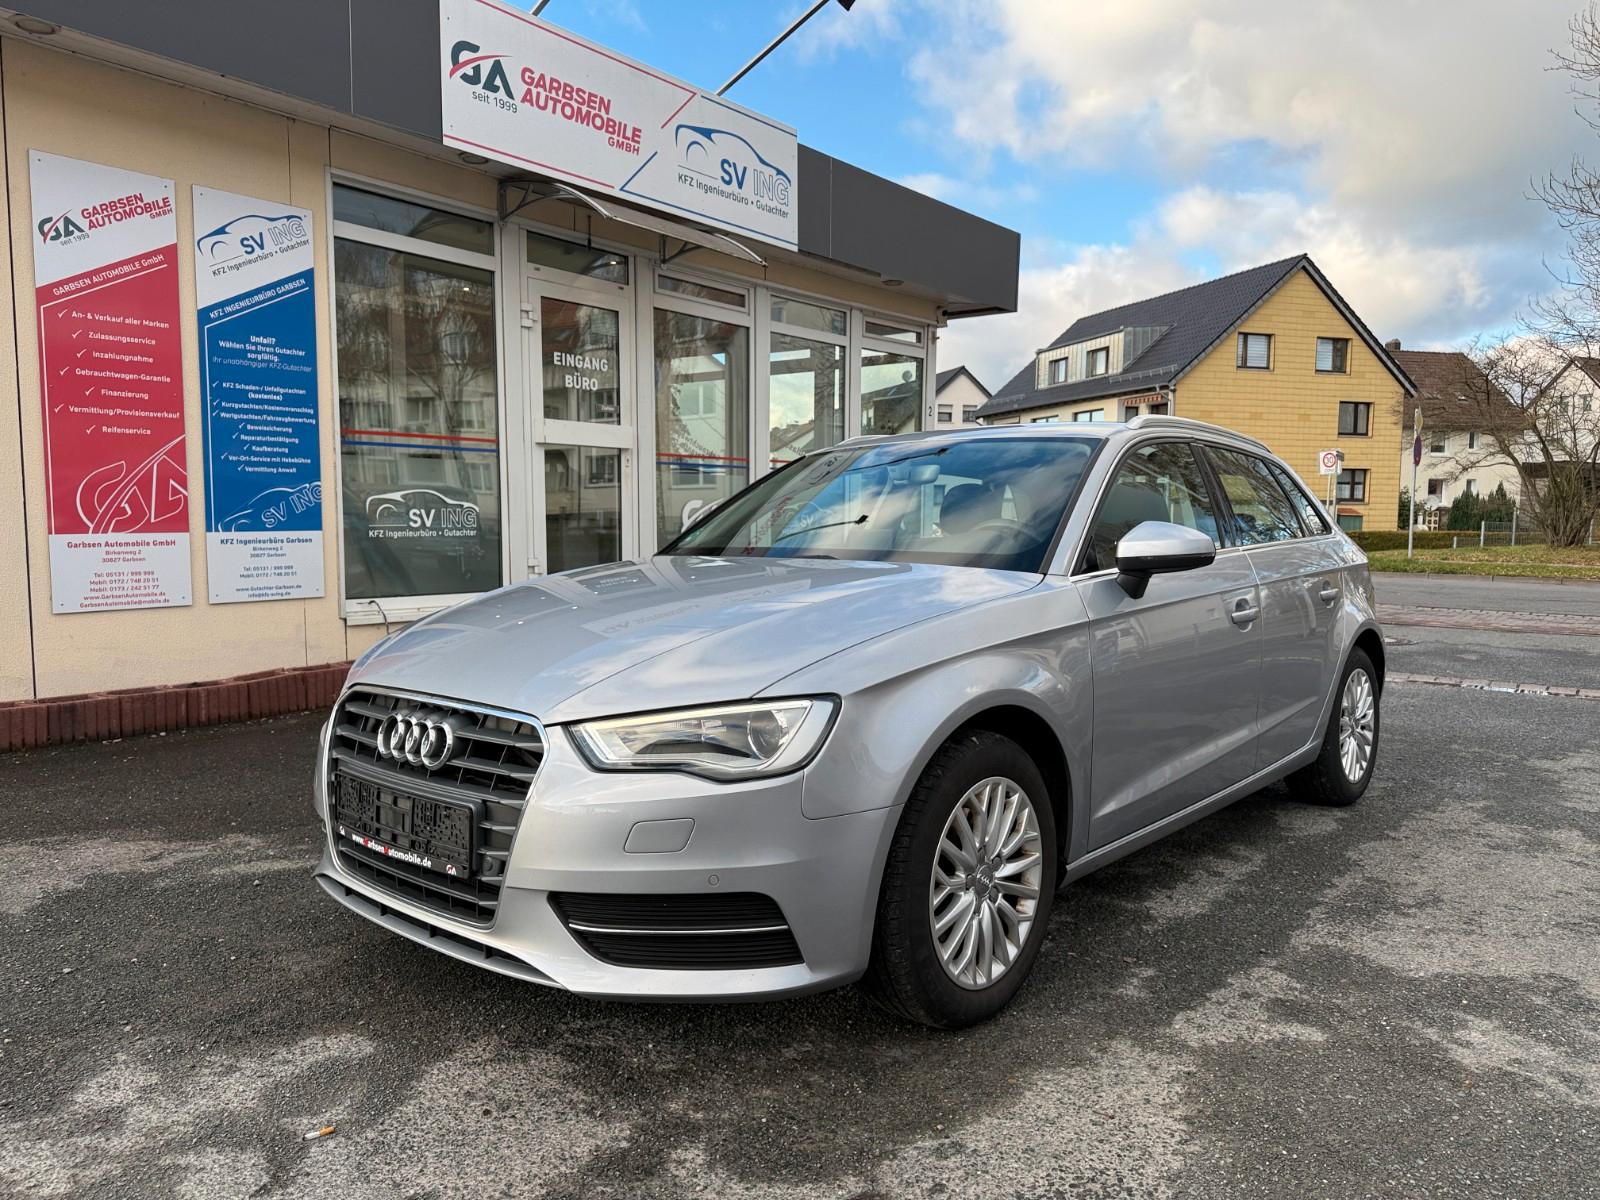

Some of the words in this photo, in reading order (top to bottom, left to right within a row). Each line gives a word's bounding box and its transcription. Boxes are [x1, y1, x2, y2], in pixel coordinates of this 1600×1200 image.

[520, 67, 611, 115] GARBSEN
[472, 91, 490, 105] seit
[494, 97, 518, 113] 1999
[520, 88, 642, 145] AUTOMOBILE
[608, 137, 640, 156] GMBH
[720, 158, 747, 190] SV
[753, 168, 789, 207] ING
[678, 173, 694, 188] KFZ
[696, 179, 749, 206] Ingenieurbüro
[756, 201, 789, 219] Gutachter
[81, 193, 144, 220] GARBSEN
[88, 196, 171, 231] AUTOMOBILE
[150, 207, 173, 220] GMBH
[60, 236, 72, 247] seit
[73, 232, 90, 244] 1999
[240, 231, 266, 255] SV
[267, 218, 307, 247] ING
[212, 266, 227, 278] KFZ
[227, 250, 274, 273] Ingenieurbüro
[279, 238, 310, 255] Gutachter
[53, 277, 92, 296] GARBSEN
[92, 261, 141, 285] AUTOMOBILE
[142, 254, 165, 267] GmbH
[209, 308, 224, 319] KFZ
[224, 289, 277, 315] INGENIEURBÜRO
[276, 278, 306, 295] GARBSEN
[94, 313, 123, 323] Verkauf
[124, 317, 141, 326] aller
[143, 320, 170, 329] Marken
[88, 331, 156, 345] Zulassungsservice
[250, 335, 276, 345] Unfall?
[218, 340, 245, 350] Wählen
[245, 343, 257, 351] Sie
[257, 345, 274, 353] Ihren
[275, 346, 306, 357] Gutachter
[92, 351, 154, 363] Inzahlungnahme
[247, 352, 280, 362] sorgfältig.
[553, 351, 609, 372] EINGANG
[223, 357, 268, 369] unabhängiger
[269, 363, 312, 373] KFZ-Gutachter
[75, 368, 171, 383] Gebrauchtwagen-Garantie
[565, 372, 599, 392] BÜRO
[101, 389, 149, 400] Finanzierung
[248, 392, 283, 402] (kostenlos)
[264, 385, 307, 395] Unfallgutachten
[68, 405, 180, 419] Vermittlung/Provisionsverkauf
[221, 401, 314, 415] Kurzgutachten/Kostenvoranschlag
[928, 405, 933, 417] 2
[219, 411, 316, 425] Wertgutachten/Fahrzeugbewertung
[102, 426, 151, 435] Reifenservice
[246, 424, 293, 433] Beweissicherung
[240, 434, 299, 444] Reparaturbestätigung
[252, 445, 289, 454] Kaufberatung
[244, 465, 277, 474] Vermittlung
[261, 501, 289, 529] SV
[408, 507, 436, 529] SV
[440, 507, 477, 529] ING
[236, 537, 285, 546] Ingenieurbüro
[368, 529, 385, 538] KFZ
[385, 528, 437, 540] Ingenieurbüro
[443, 528, 477, 538] Gutachter
[67, 541, 102, 549] Garbsen
[104, 540, 151, 548] Automobile
